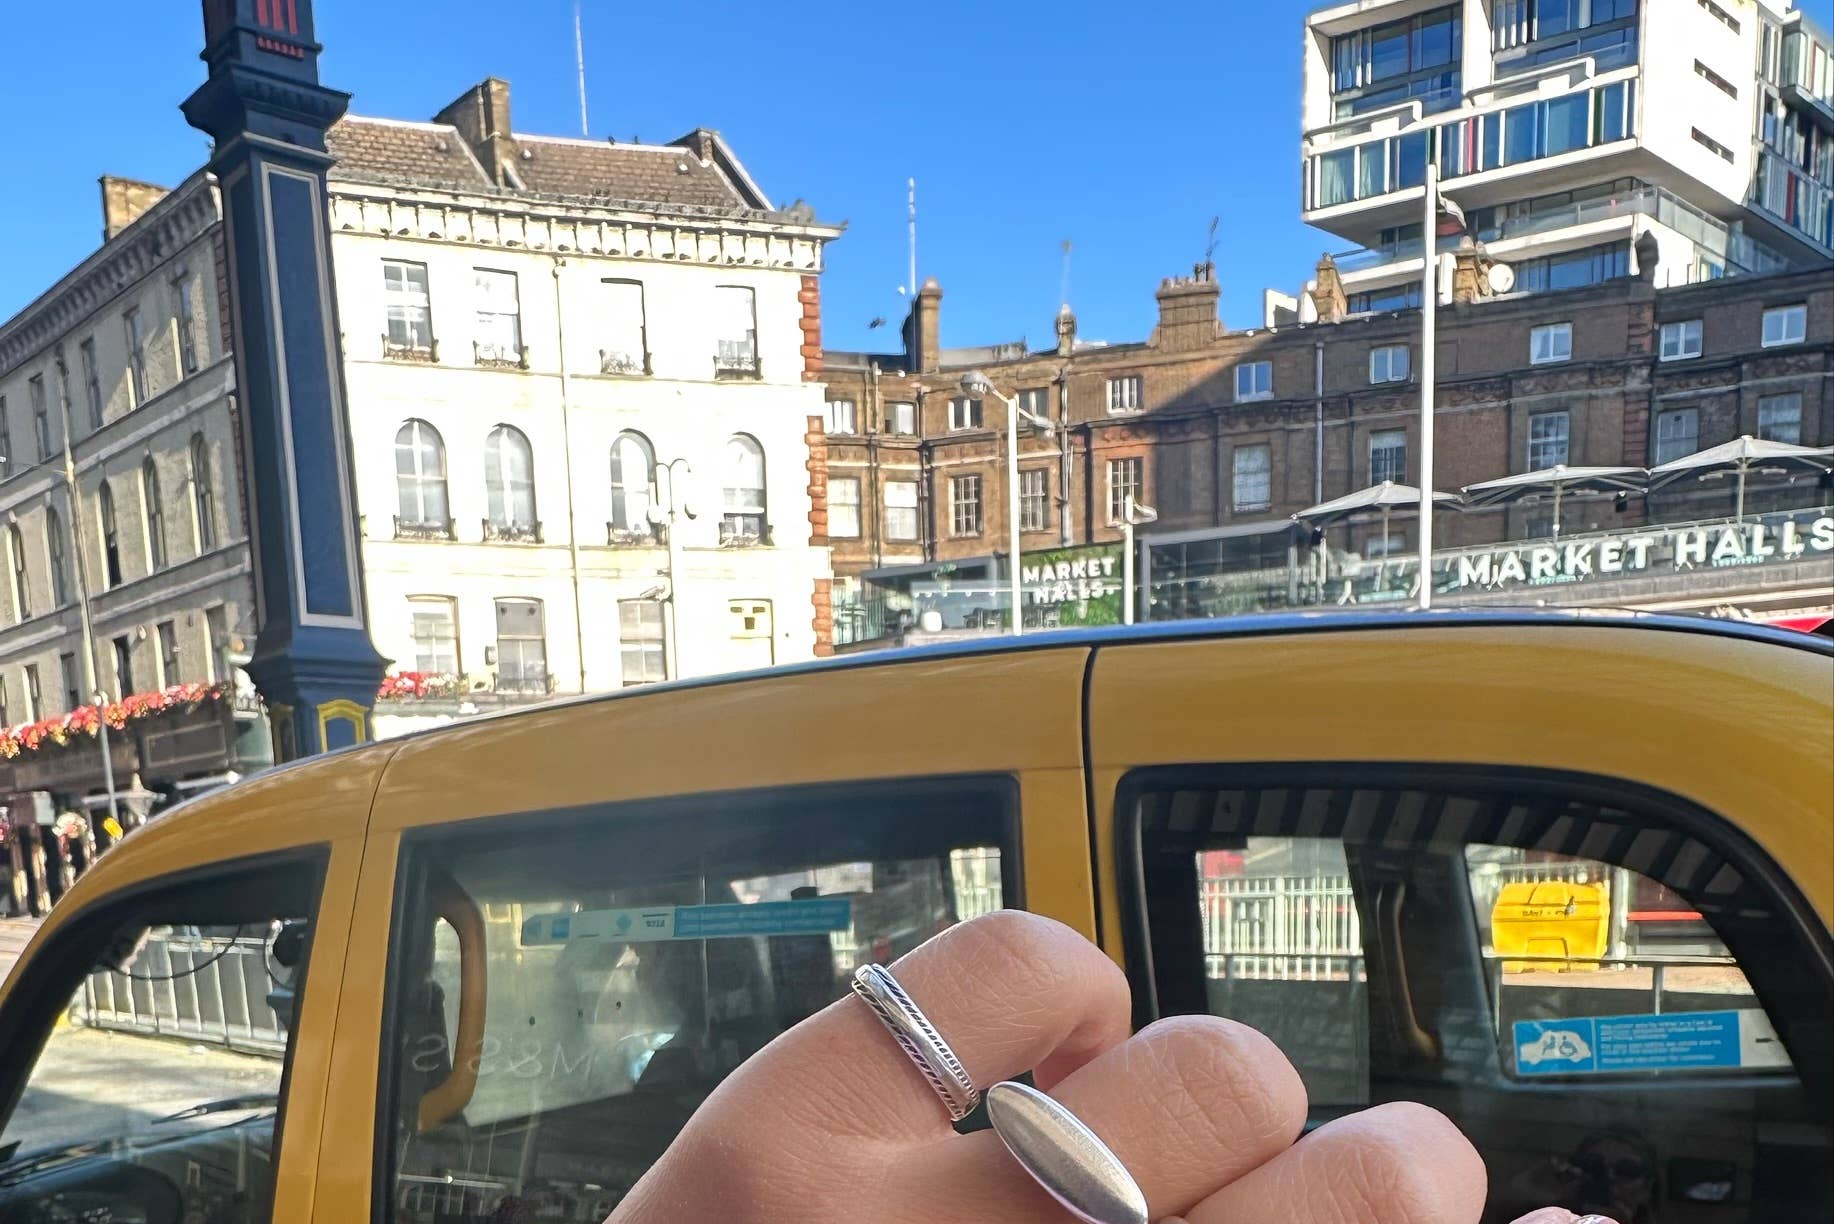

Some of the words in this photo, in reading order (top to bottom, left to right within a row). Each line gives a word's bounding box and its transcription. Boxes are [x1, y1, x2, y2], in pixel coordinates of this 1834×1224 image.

[1022, 556, 1115, 584] MARKET
[1459, 536, 1654, 587] MARKET
[1676, 517, 1834, 563] HALLS
